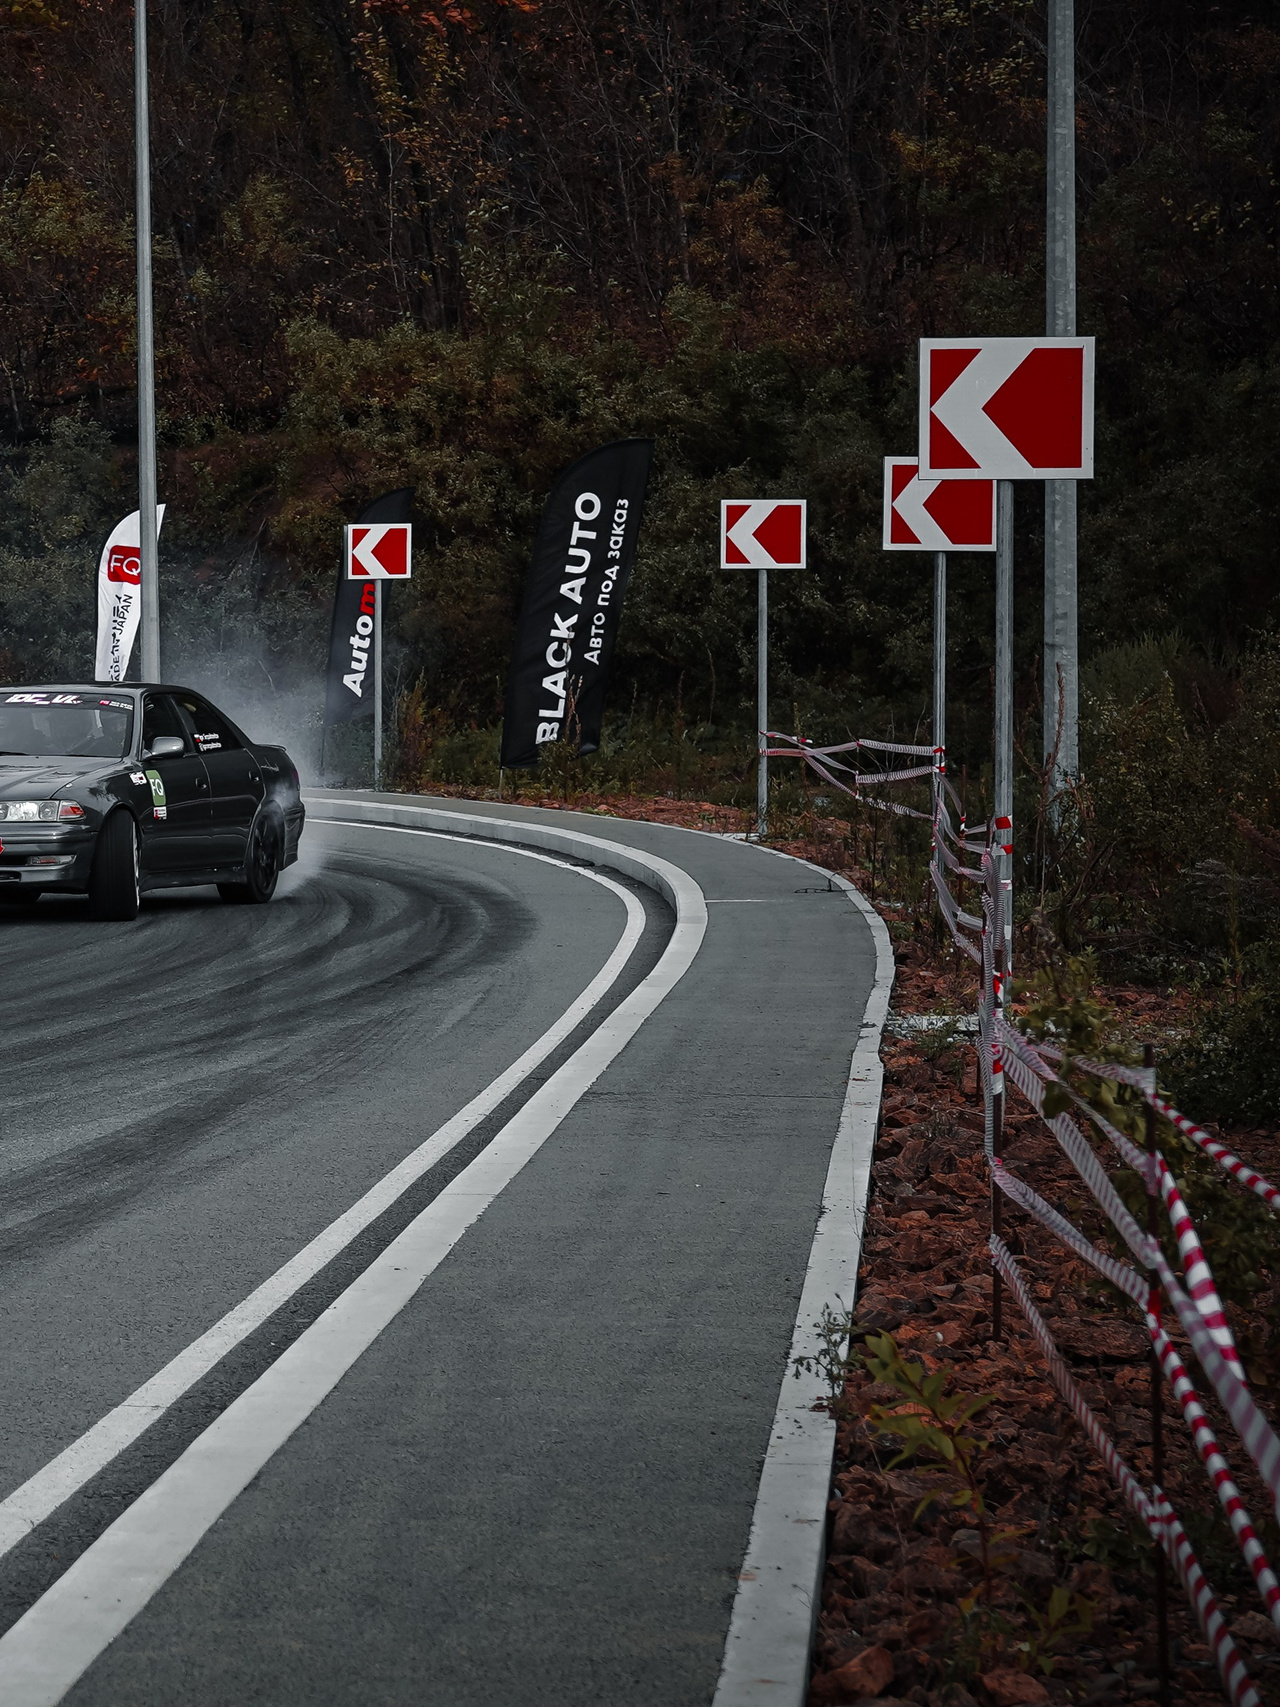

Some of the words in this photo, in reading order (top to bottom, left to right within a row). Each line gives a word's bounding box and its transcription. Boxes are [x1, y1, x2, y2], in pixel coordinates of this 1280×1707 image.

[607, 498, 630, 560] заказ
[597, 565, 620, 606] под
[115, 594, 133, 635] JAPAN
[535, 612, 579, 745] BLACK
[559, 491, 602, 605] AUTO
[149, 778, 164, 796] FQ
